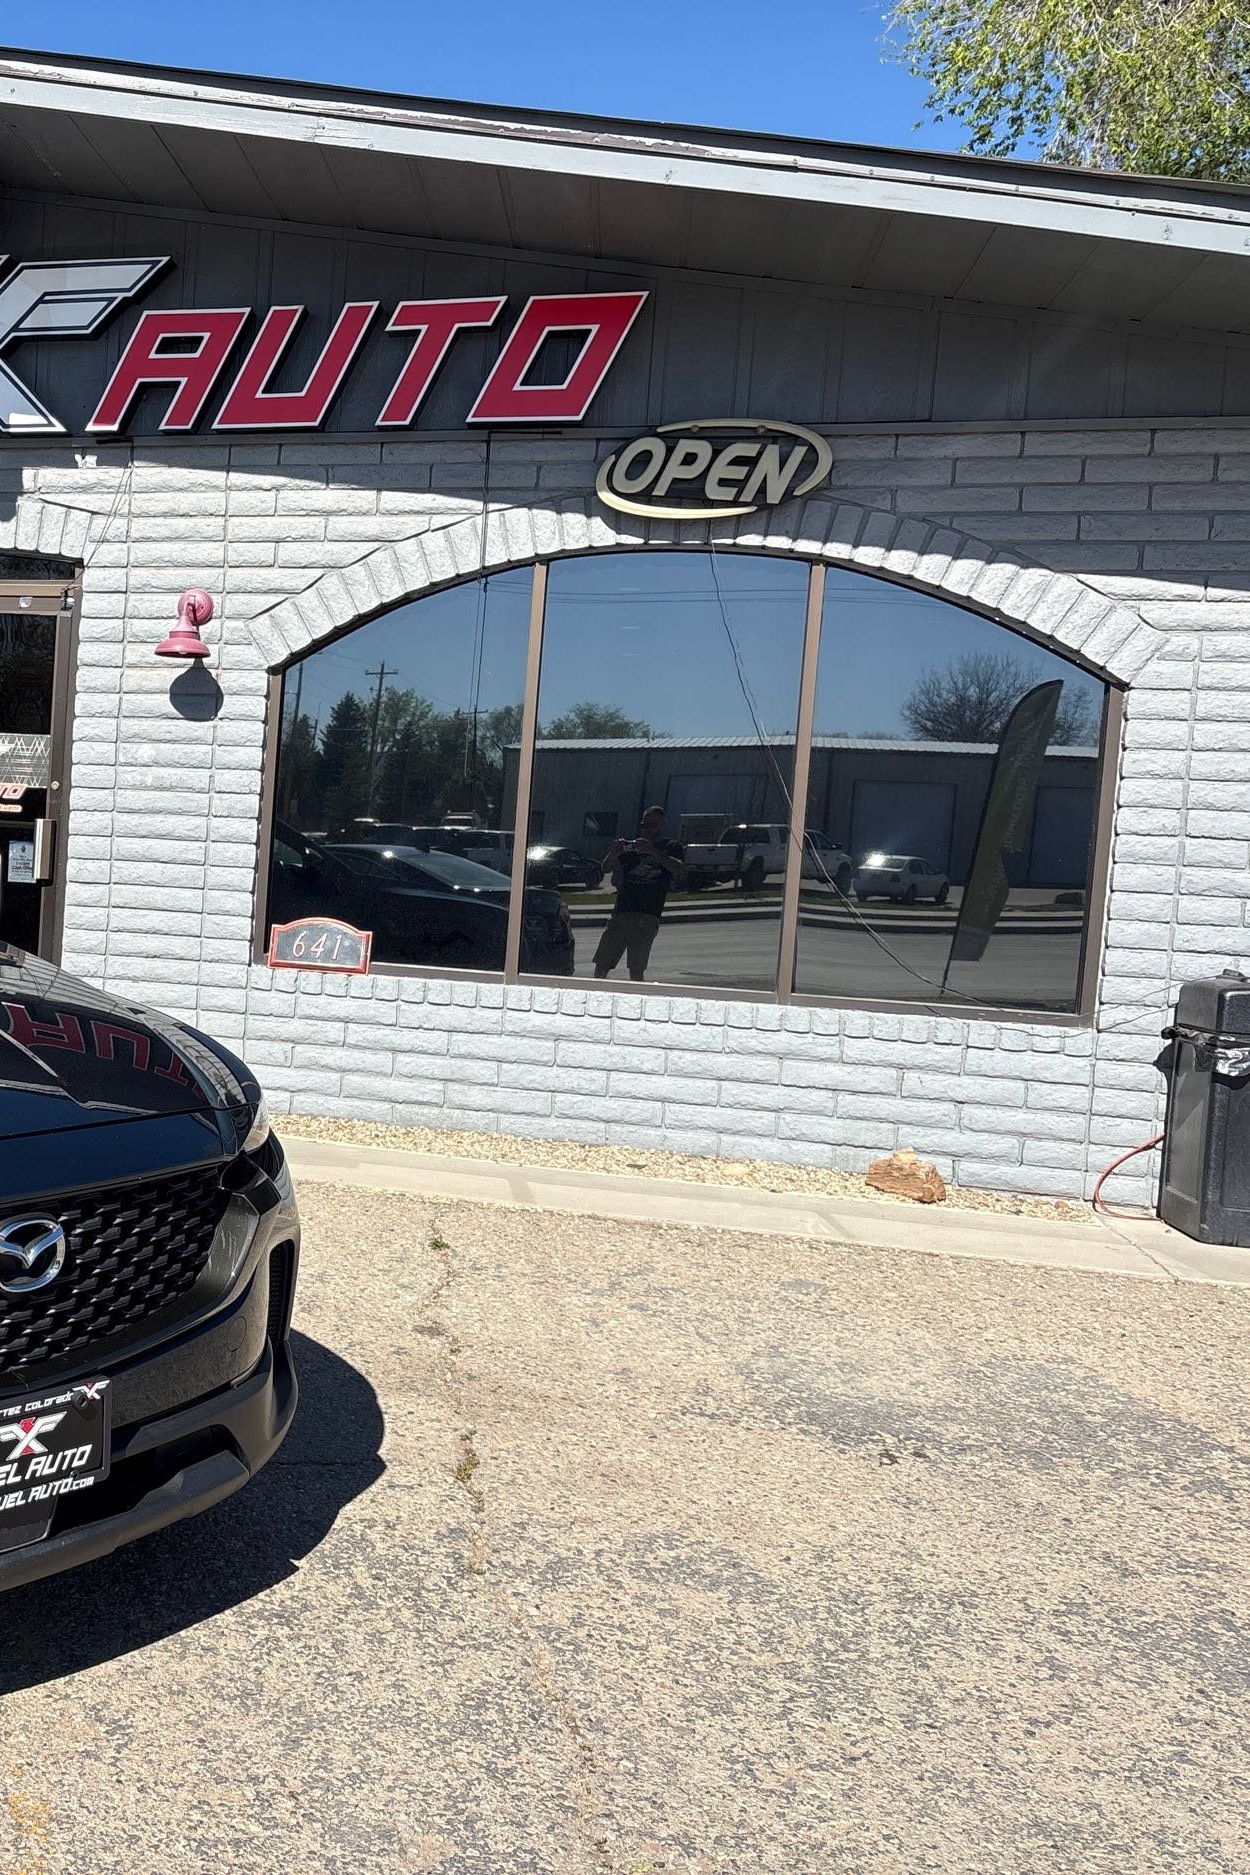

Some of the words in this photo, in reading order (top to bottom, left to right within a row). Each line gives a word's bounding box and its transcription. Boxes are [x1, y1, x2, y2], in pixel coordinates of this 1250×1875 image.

[86, 291, 649, 433] AUTO
[612, 437, 808, 504] OPEN
[293, 931, 342, 960] 641
[25, 1444, 93, 1480] AUTO
